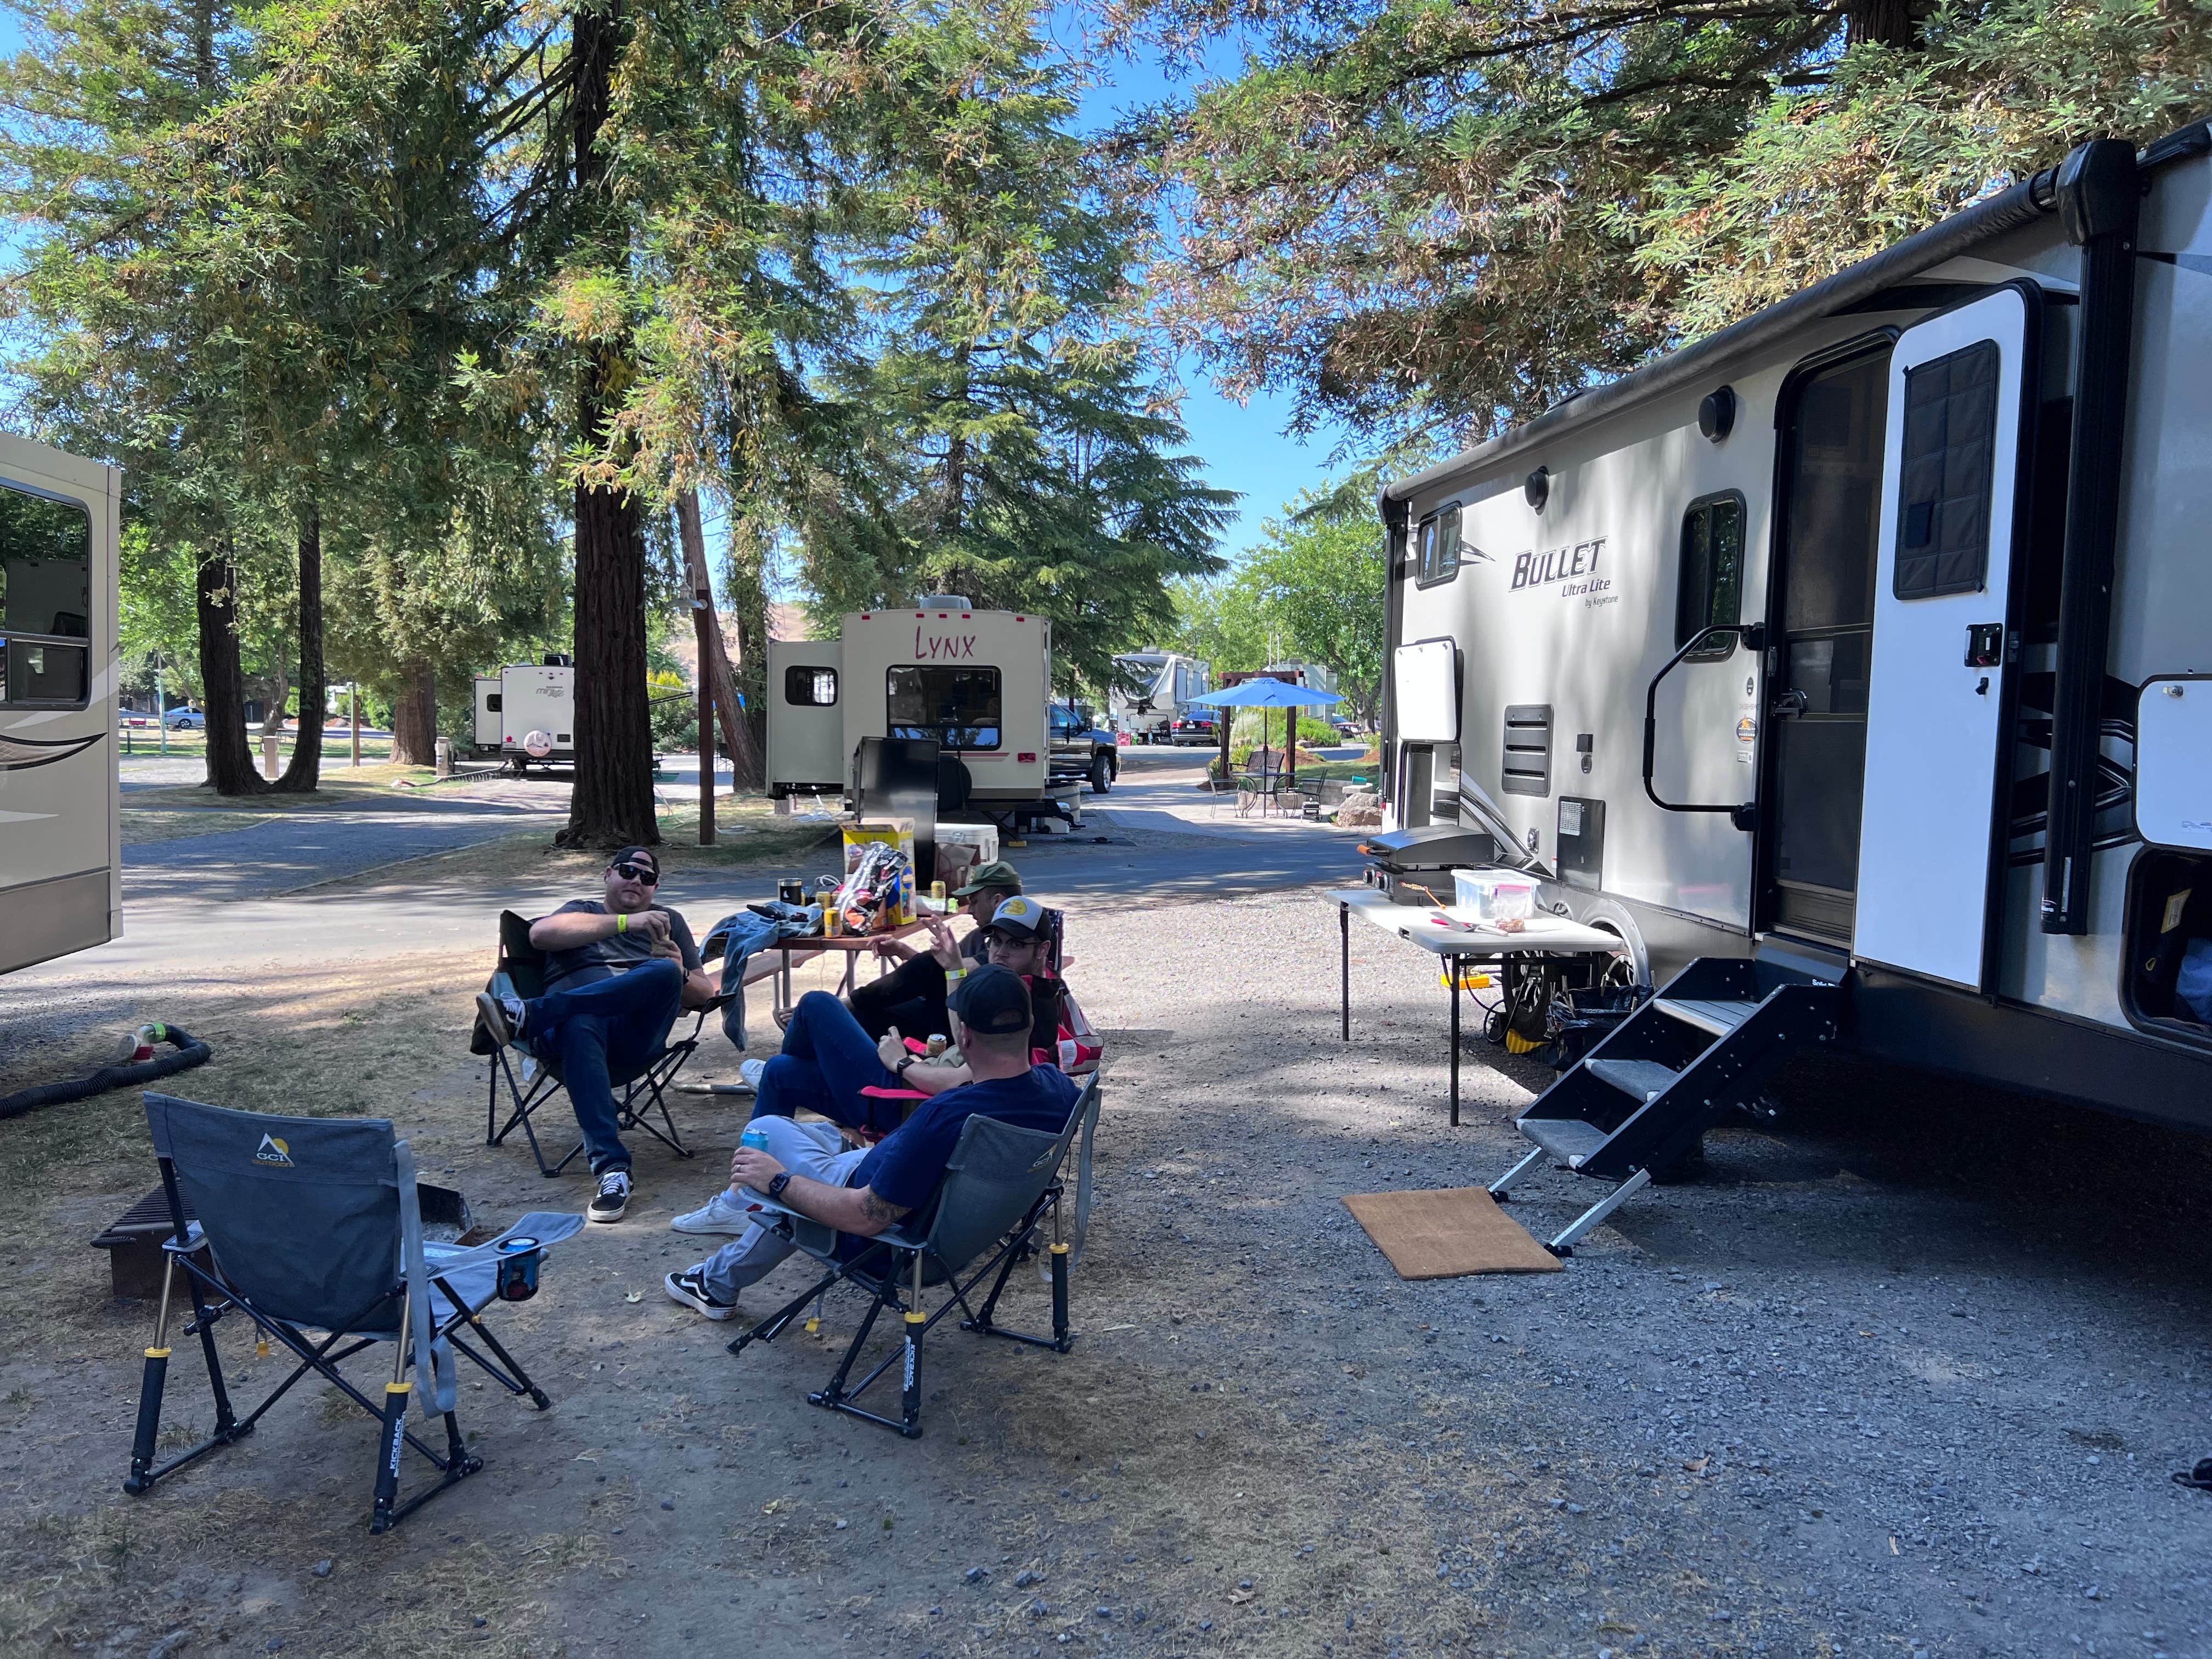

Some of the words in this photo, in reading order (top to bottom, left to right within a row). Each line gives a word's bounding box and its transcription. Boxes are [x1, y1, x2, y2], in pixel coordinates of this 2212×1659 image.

[1510, 536, 1607, 592] BULLET
[1562, 584, 1587, 597] Ultra
[1589, 578, 1611, 592] Lite
[1585, 599, 1592, 608] by
[1593, 595, 1618, 607] Keystone
[916, 625, 976, 659] LYNX
[256, 1152, 286, 1161] GCI
[390, 1418, 402, 1470] KICKBACK
